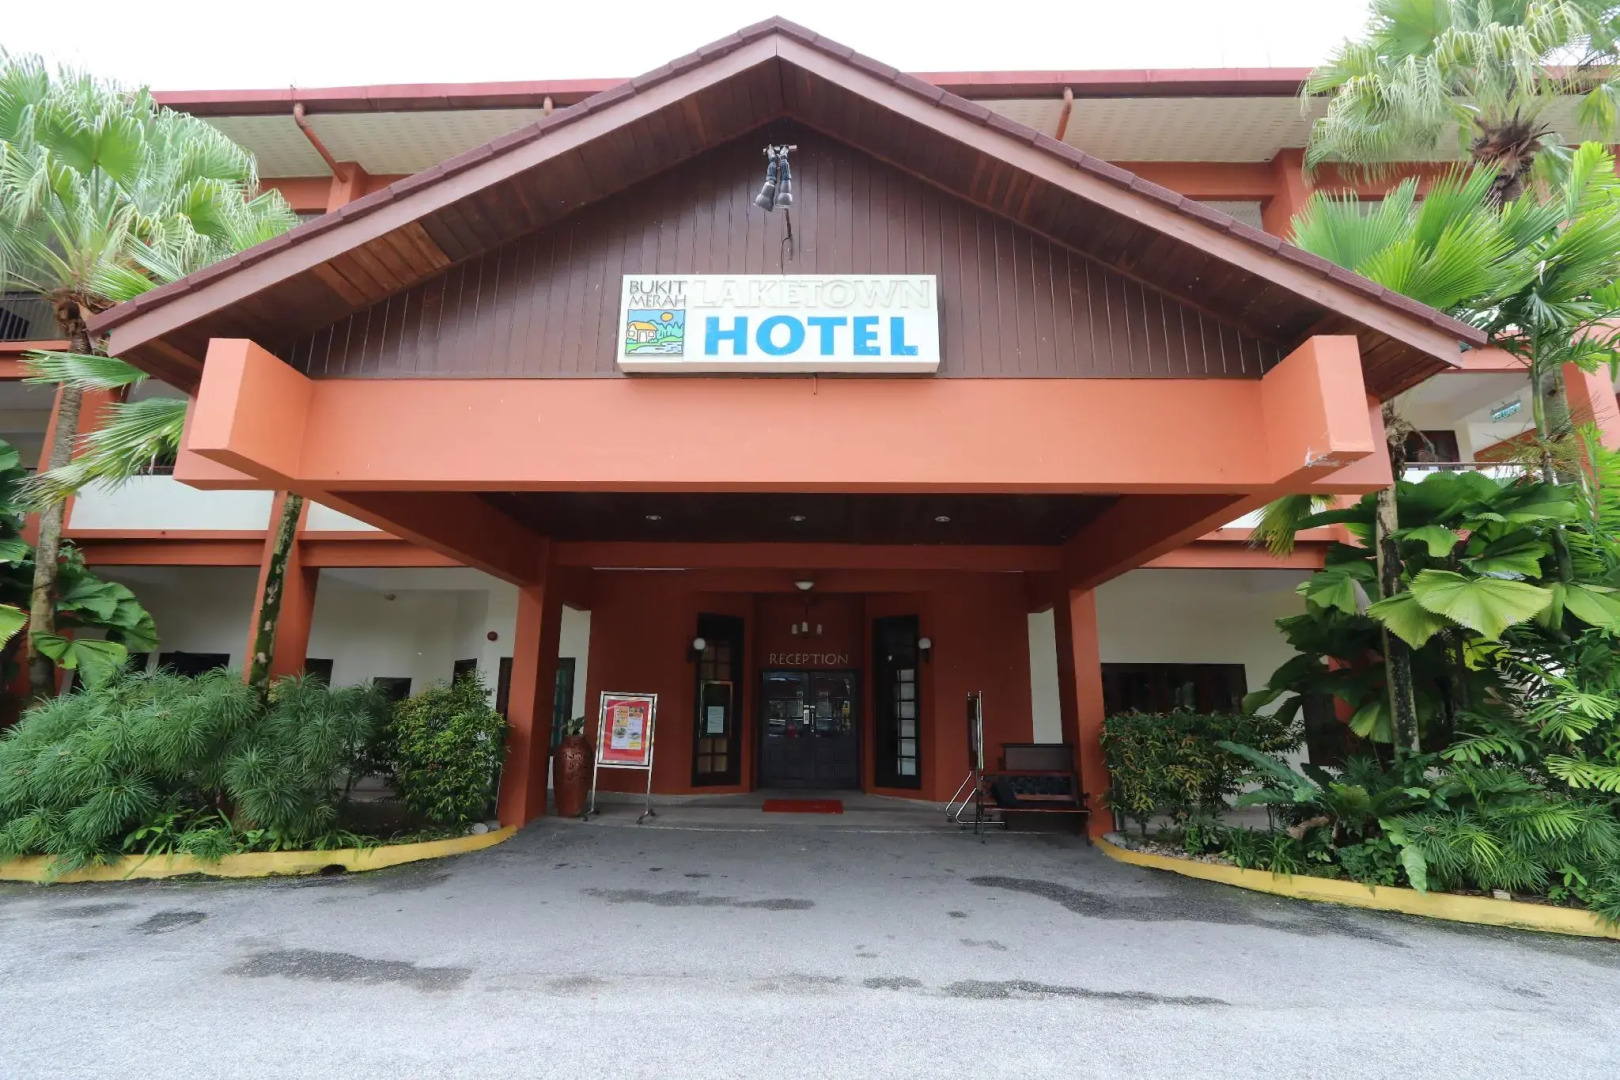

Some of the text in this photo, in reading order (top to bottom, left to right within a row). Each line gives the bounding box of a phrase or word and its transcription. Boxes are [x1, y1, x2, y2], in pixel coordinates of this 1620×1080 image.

[630, 280, 687, 294] BUKIT
[692, 279, 931, 308] LAKETOWN
[629, 294, 686, 307] MERAH
[704, 315, 919, 356] HOTEL
[769, 653, 849, 665] RECEPTION
